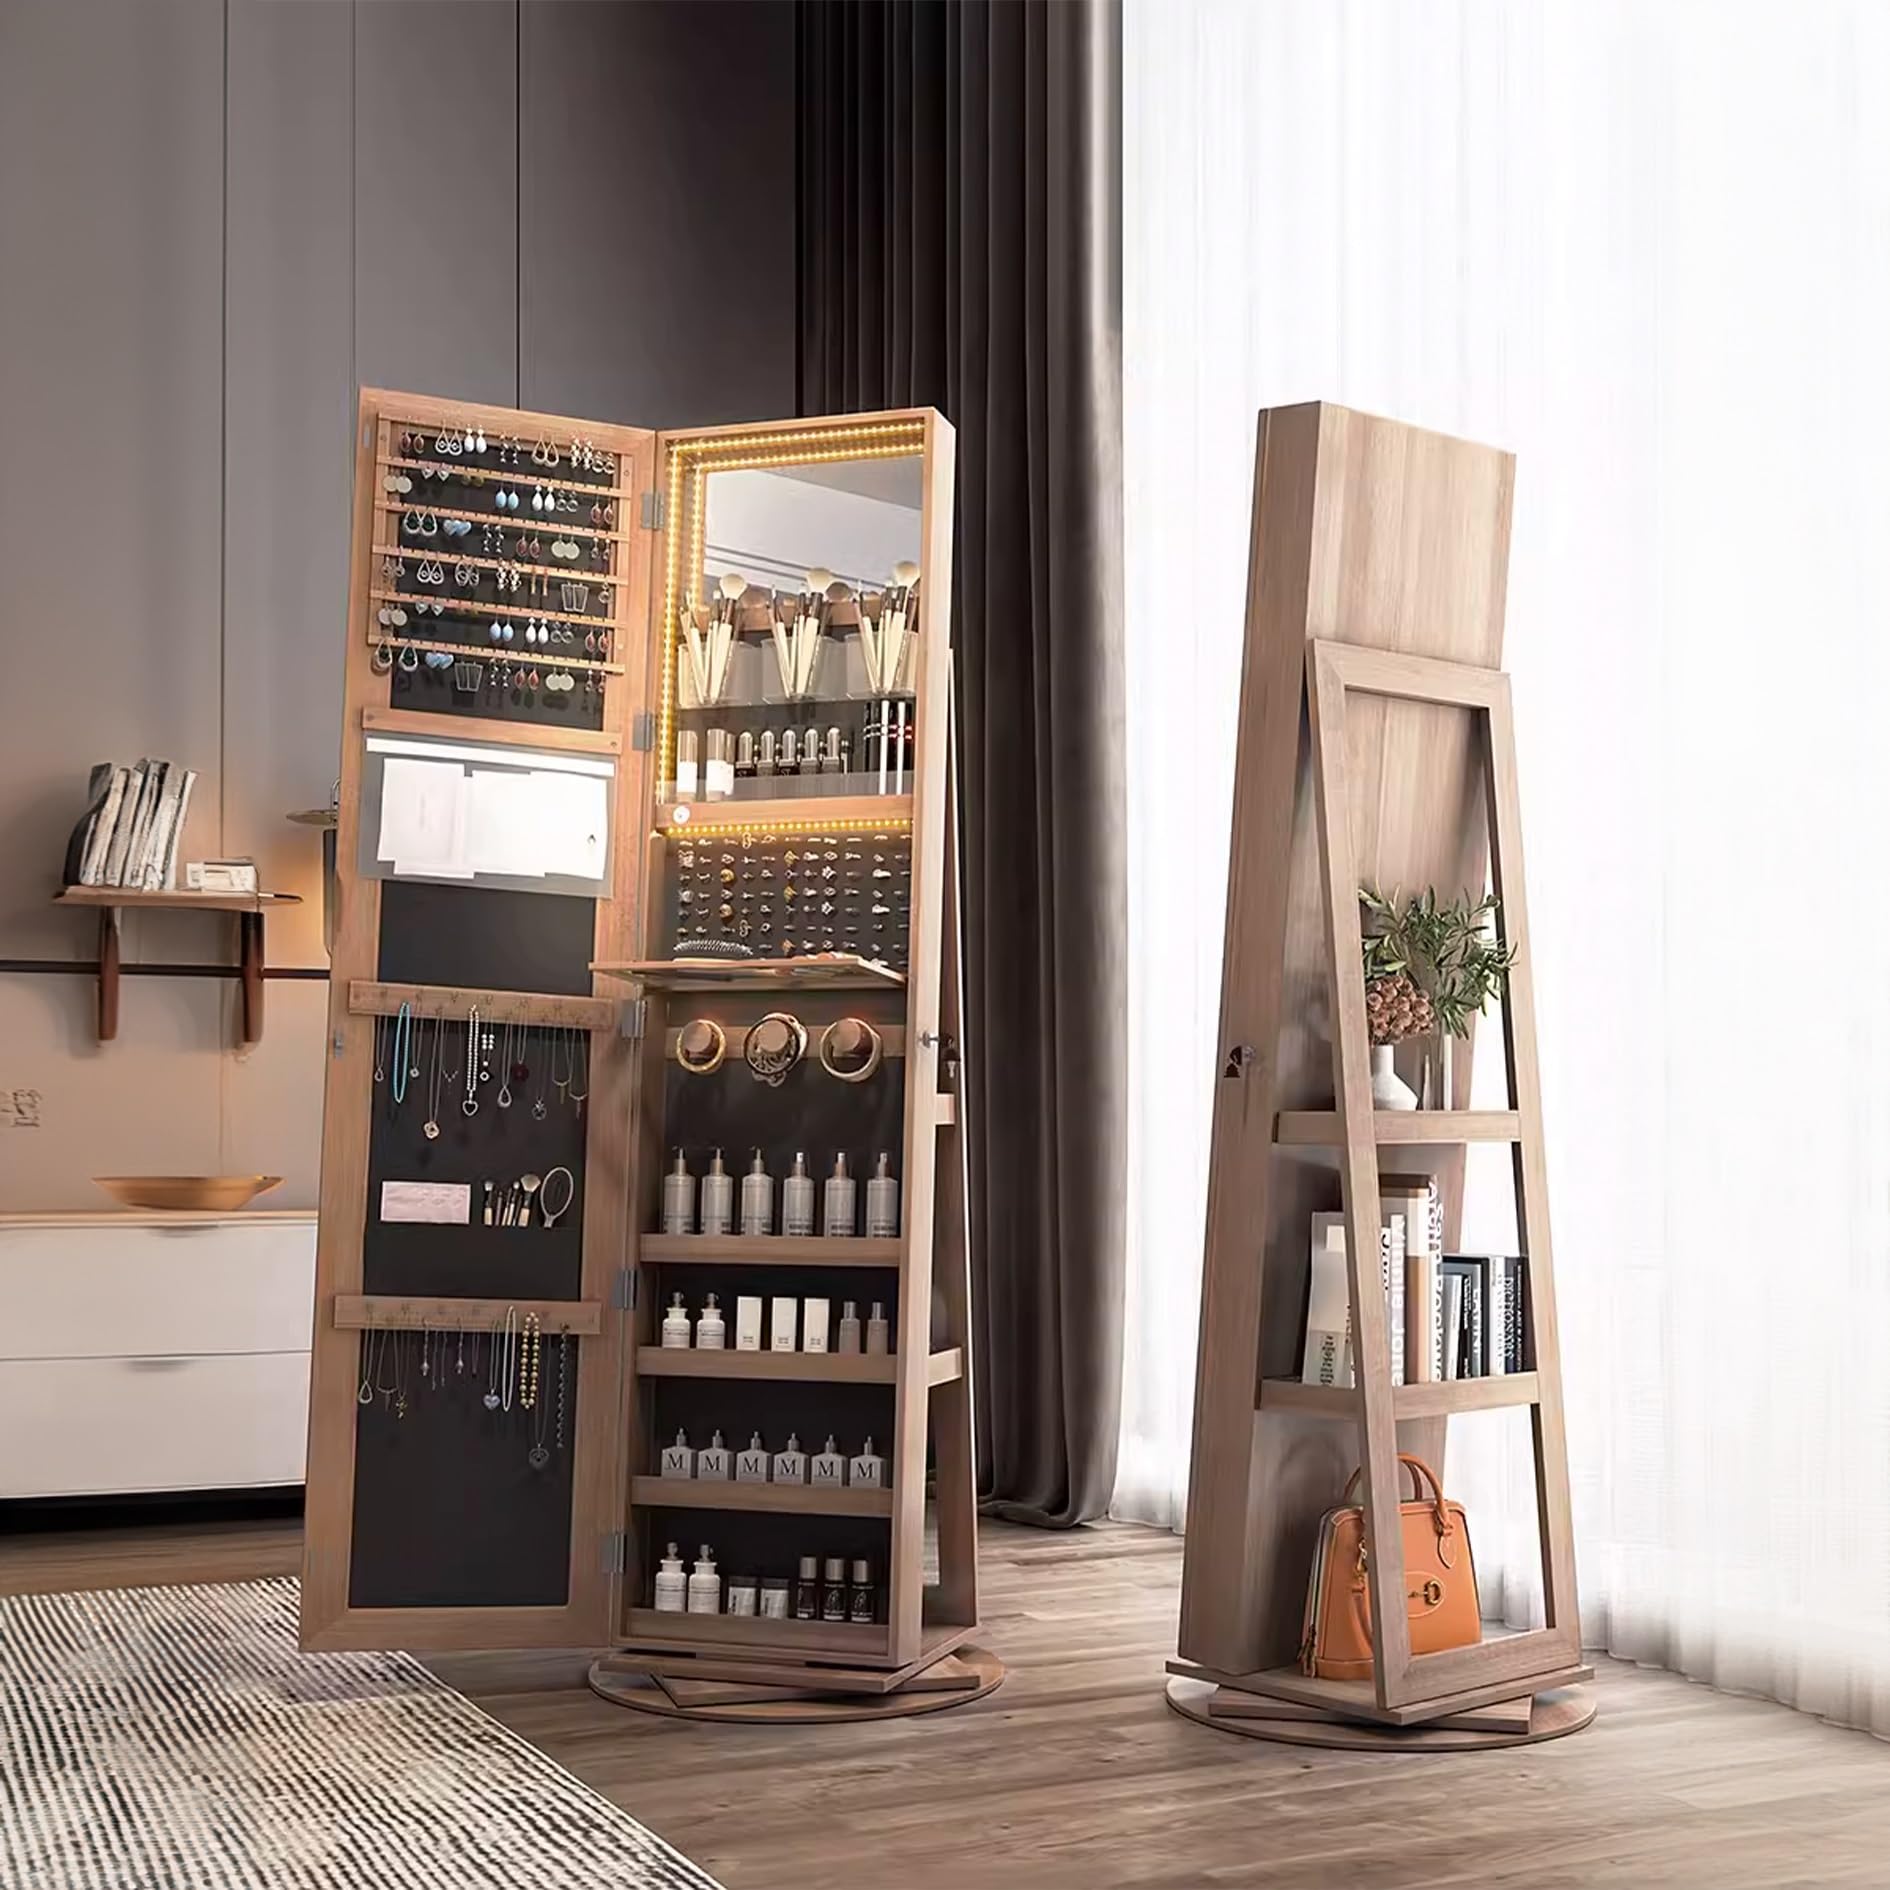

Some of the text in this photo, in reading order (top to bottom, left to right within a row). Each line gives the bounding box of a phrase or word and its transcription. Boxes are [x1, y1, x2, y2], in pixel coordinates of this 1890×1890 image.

[667, 1453, 684, 1470] M
[704, 1455, 721, 1471] M
[743, 1457, 759, 1473] M
[780, 1459, 797, 1475] M
[818, 1460, 834, 1477] M
[856, 1462, 873, 1479] M
